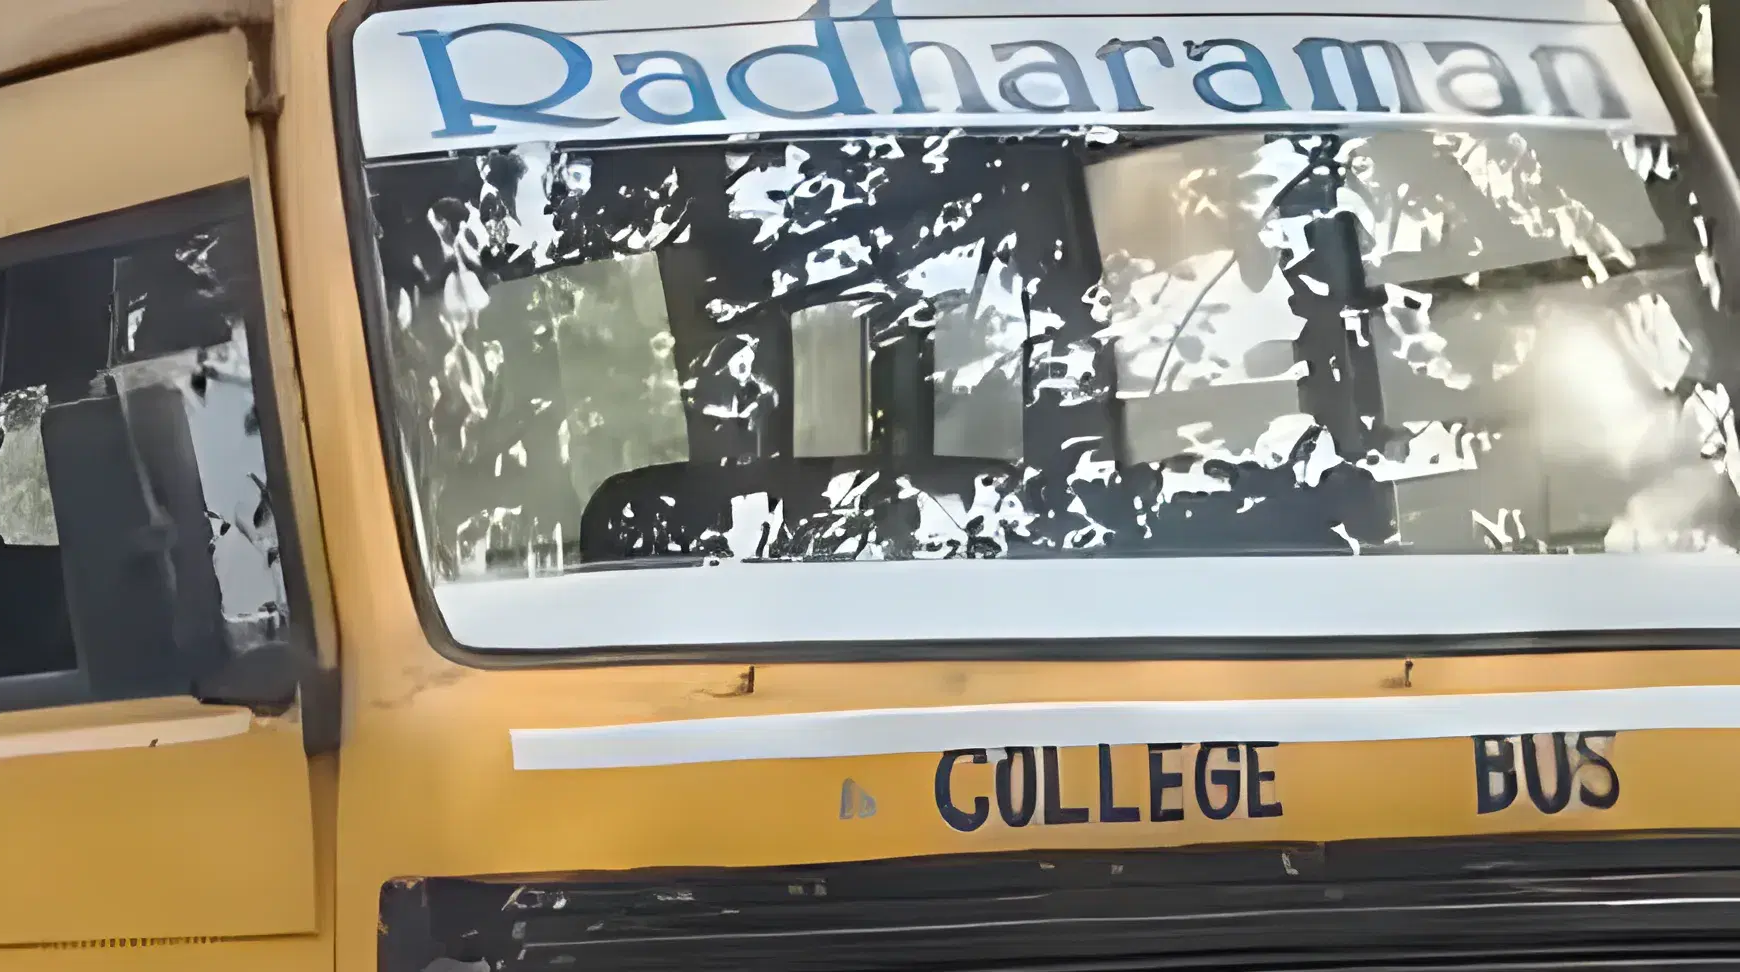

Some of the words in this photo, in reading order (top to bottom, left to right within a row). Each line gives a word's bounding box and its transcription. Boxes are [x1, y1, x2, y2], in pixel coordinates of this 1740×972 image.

[397, 0, 1632, 138] Radharaman
[934, 740, 1284, 832] COLLEGE
[1471, 730, 1620, 815] BUS
